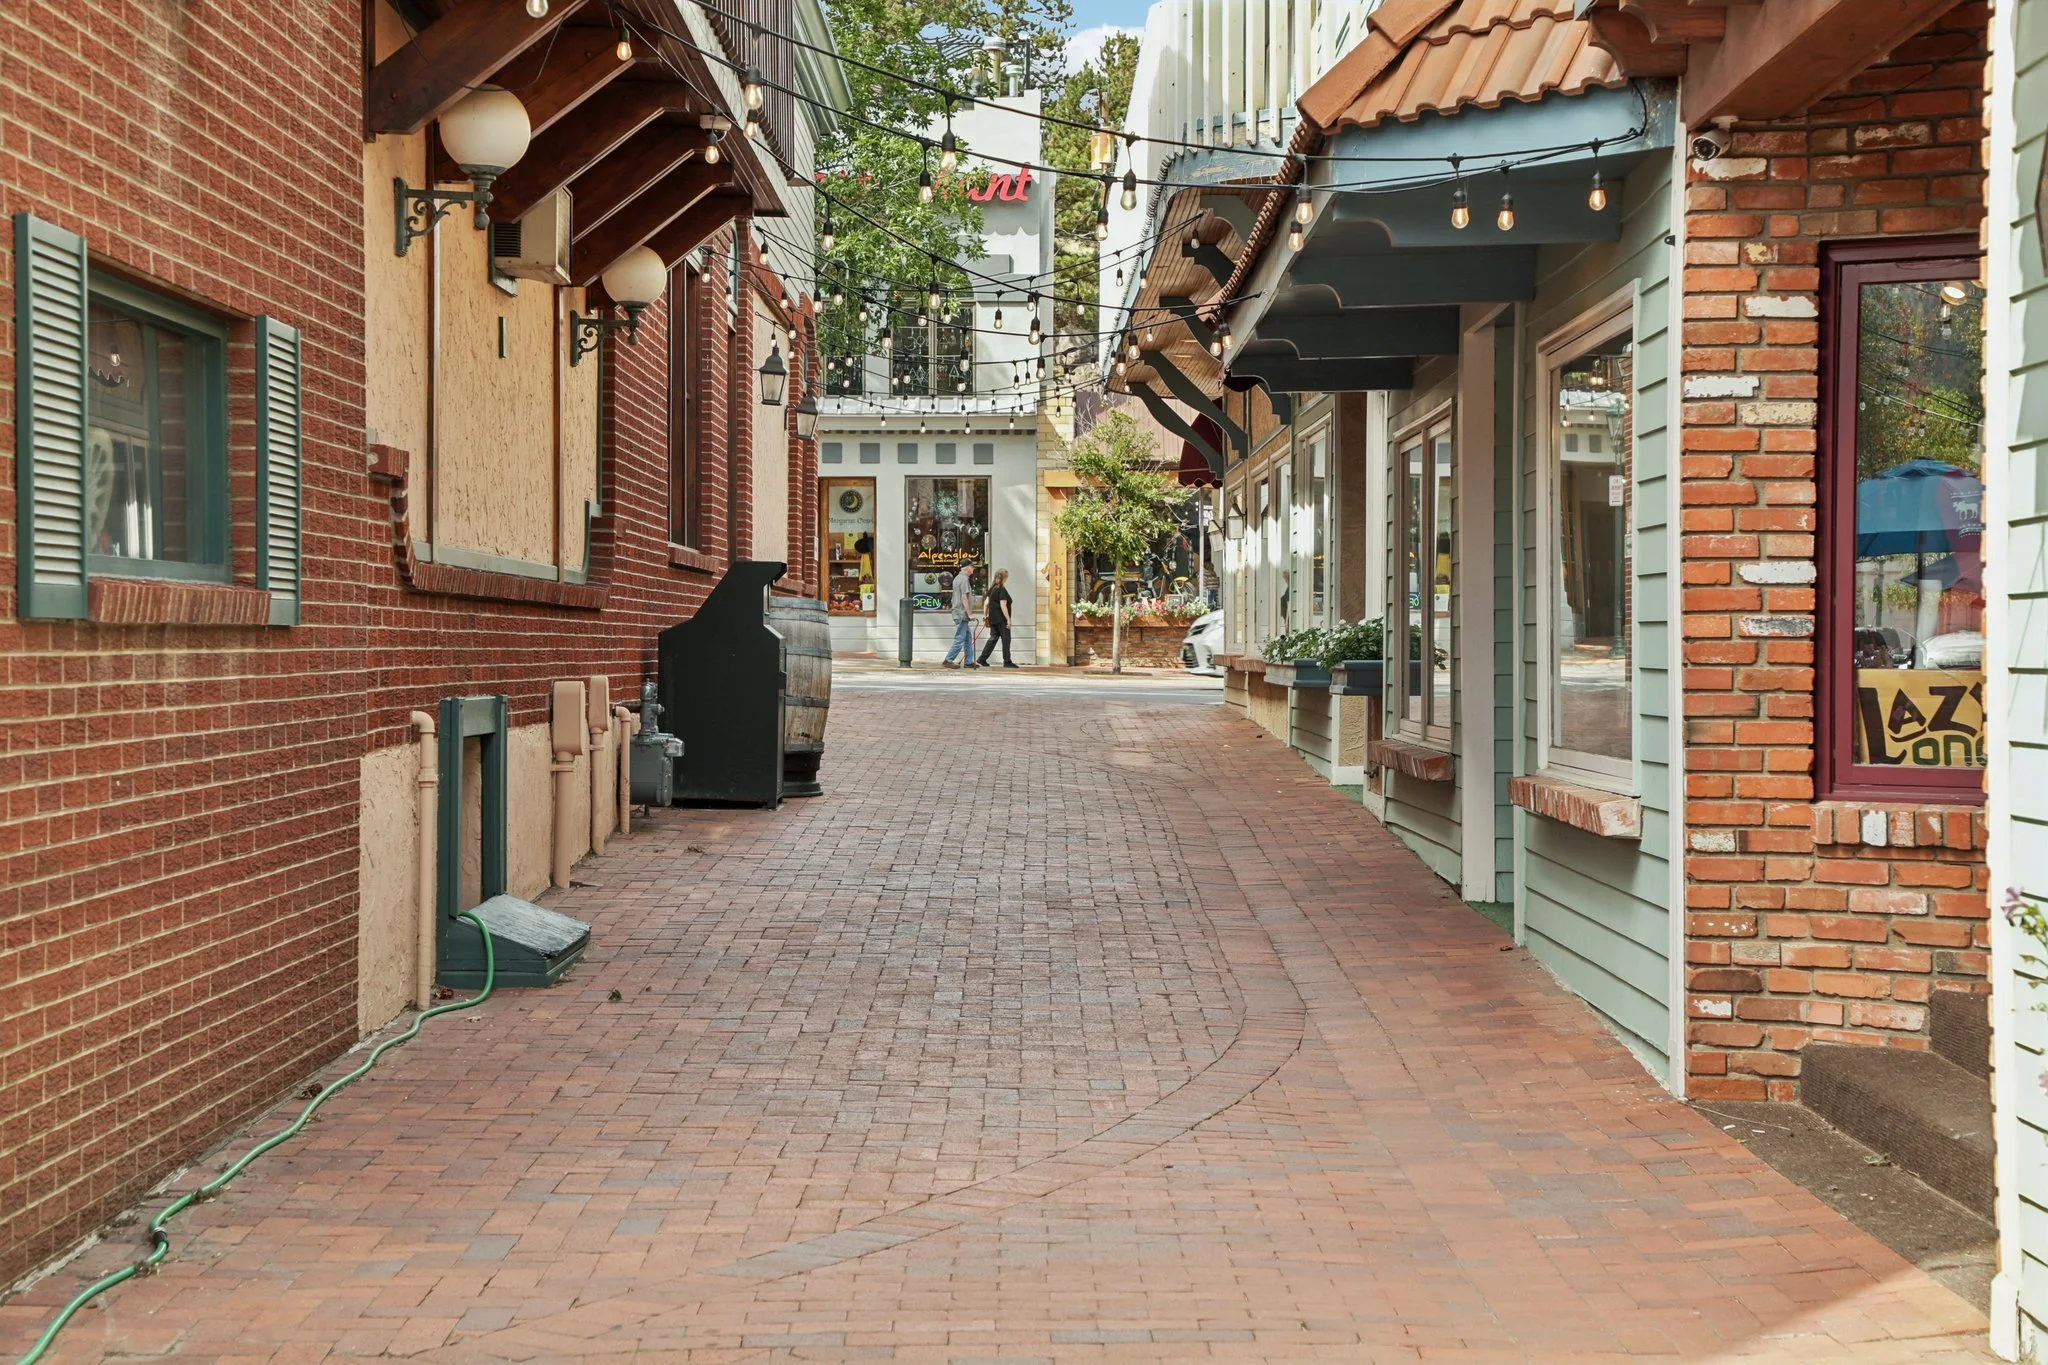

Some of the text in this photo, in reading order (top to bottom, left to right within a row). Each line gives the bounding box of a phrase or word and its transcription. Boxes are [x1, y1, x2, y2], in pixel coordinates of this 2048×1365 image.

[918, 548, 979, 566] Alpenglow
[913, 598, 940, 607] OPEN
[1859, 682, 1984, 765] LAZ
